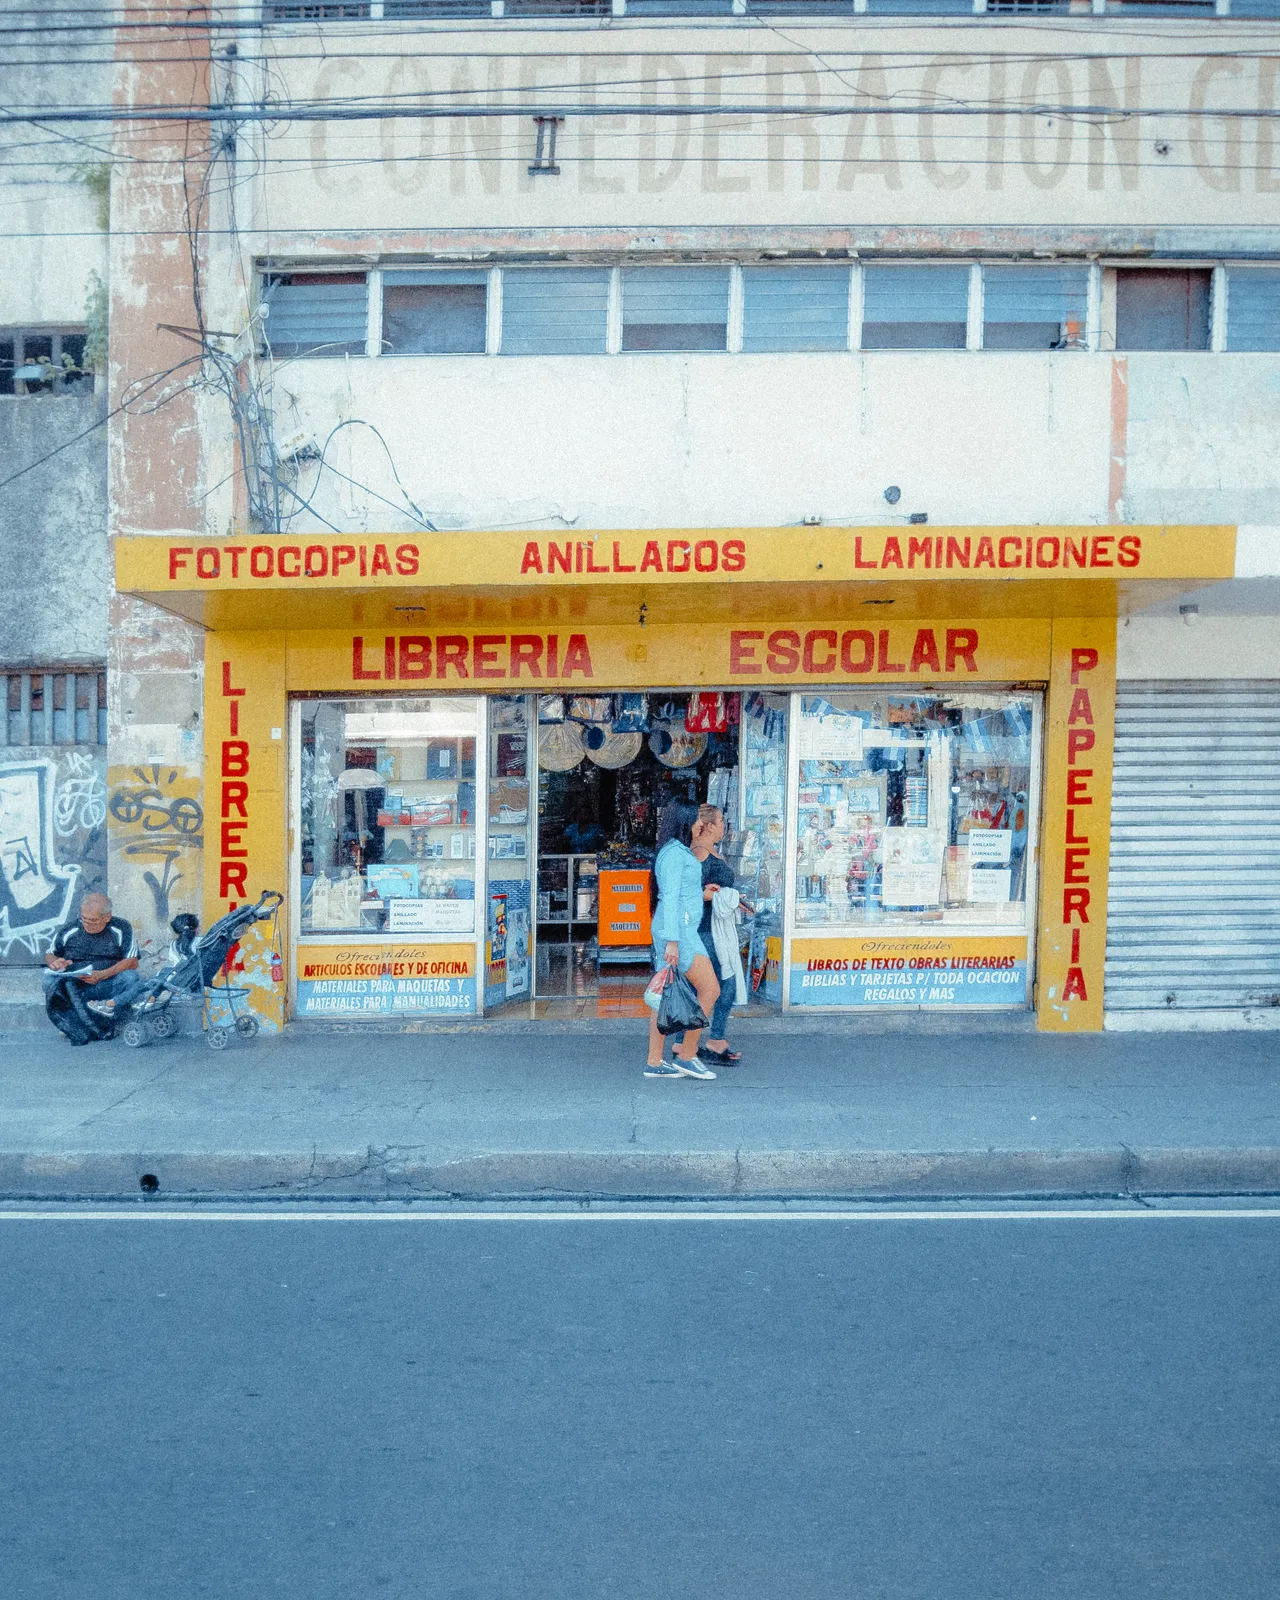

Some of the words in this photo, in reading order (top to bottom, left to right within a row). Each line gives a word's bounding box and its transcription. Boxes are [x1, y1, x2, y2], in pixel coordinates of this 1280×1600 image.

[309, 52, 1142, 196] CONFEDERACION
[520, 539, 746, 574] ANILLADOS
[854, 535, 1142, 569] LAMINACIONES
[169, 544, 420, 580] FOTOCOPIAS
[353, 634, 594, 680] LIBRERIA
[729, 628, 978, 675] ESCOLAR
[1062, 647, 1098, 1001] PAPELERIA
[861, 940, 952, 952] Ofreciendoles
[304, 963, 352, 977] ARTICULOS
[354, 962, 405, 976] ESCOLARES
[407, 962, 415, 975] Y
[416, 962, 428, 975] DE
[430, 961, 468, 975] OFICINA
[807, 958, 848, 972] LIBROS
[852, 958, 867, 971] DE
[870, 957, 905, 970] TEXTO
[908, 956, 947, 970] OBRAS
[951, 955, 1016, 969] LITERARIAS
[312, 980, 368, 994] MATERIALES
[370, 980, 395, 993] PARA
[397, 979, 451, 993] MAQUETAS
[456, 979, 465, 993] Y
[802, 973, 847, 987] BIBLIAS
[850, 973, 858, 986] Y
[860, 972, 913, 986] TARJETAS
[916, 972, 930, 986] P/
[933, 971, 963, 985] TODA
[967, 970, 1020, 984] OCACION
[306, 996, 361, 1010] MATERIALES
[363, 996, 387, 1010] PARA
[392, 994, 470, 1009] MANUALIDADES
[864, 988, 915, 1001] REGALOS
[919, 987, 927, 1000] Y
[928, 987, 955, 1000] MAS
